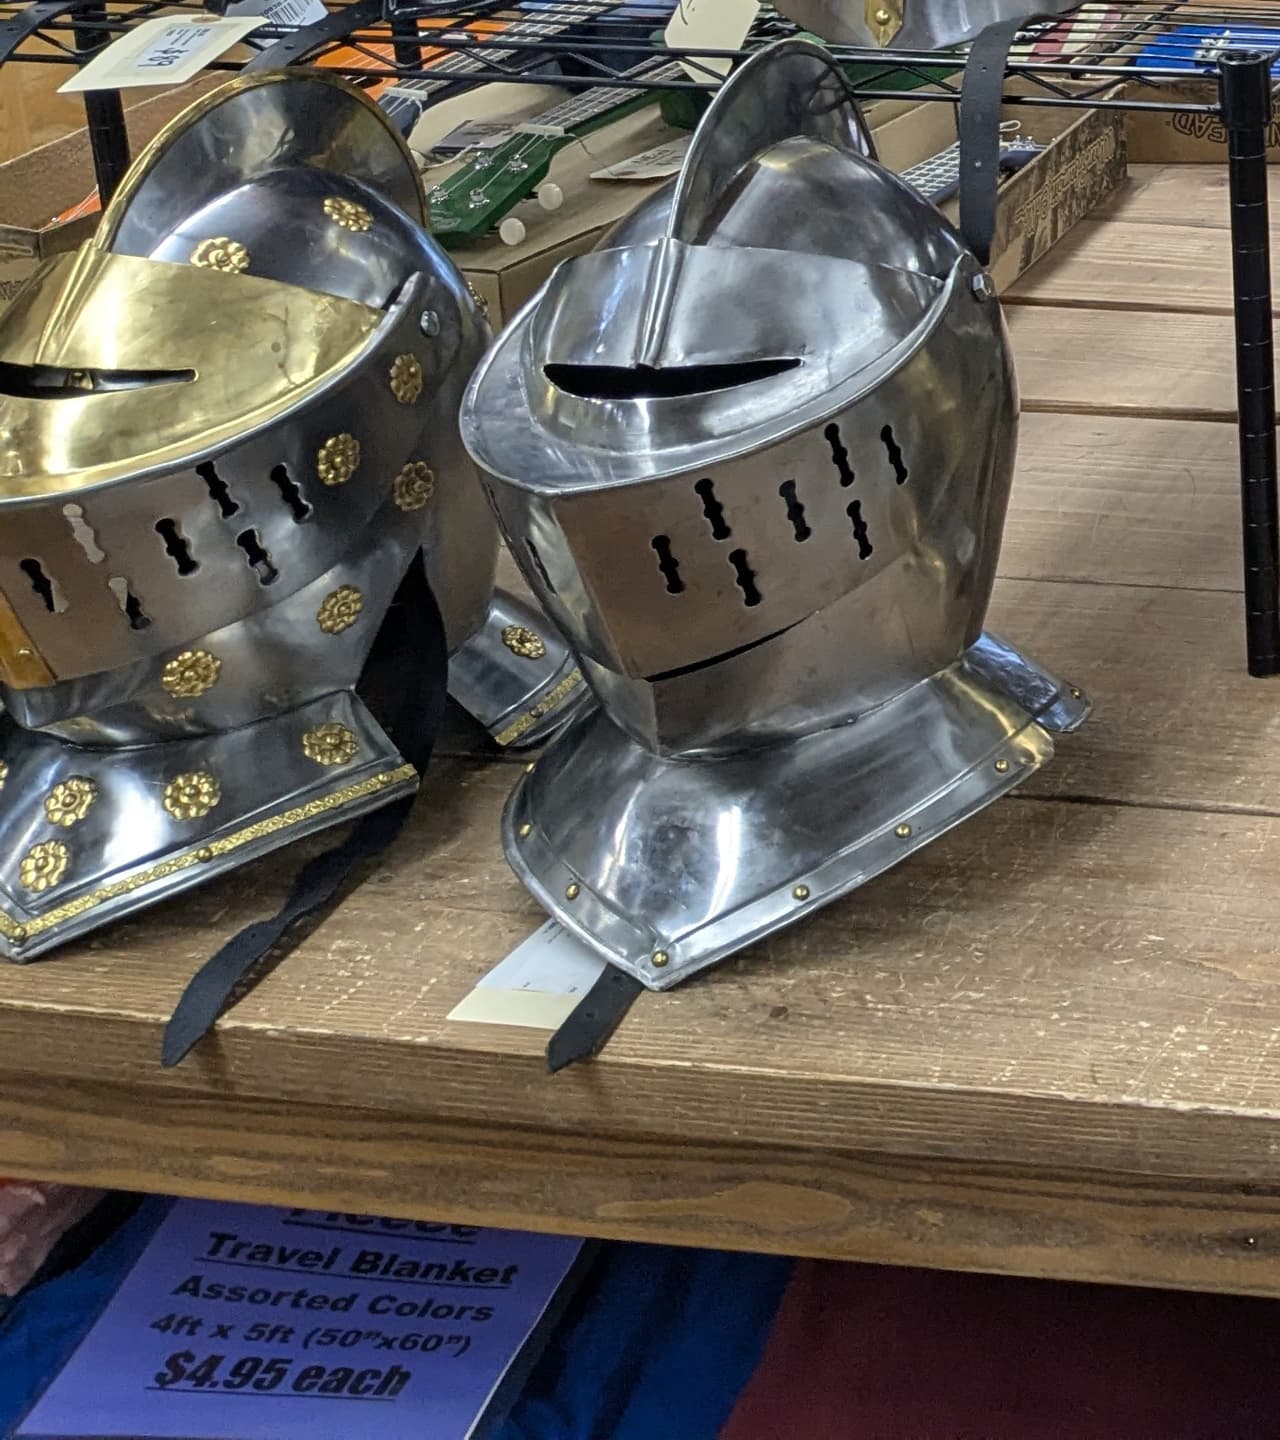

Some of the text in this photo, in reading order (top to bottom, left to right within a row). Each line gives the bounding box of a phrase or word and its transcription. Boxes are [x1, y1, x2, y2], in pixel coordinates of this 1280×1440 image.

[1173, 112, 1227, 144] EAD
[208, 1231, 519, 1287] Travel Blanket
[172, 1275, 494, 1322] Assorted Colors
[150, 1312, 197, 1339] 4ft
[210, 1323, 233, 1339] x
[248, 1320, 296, 1346] 5ft
[155, 1350, 411, 1398] $4.95 each
